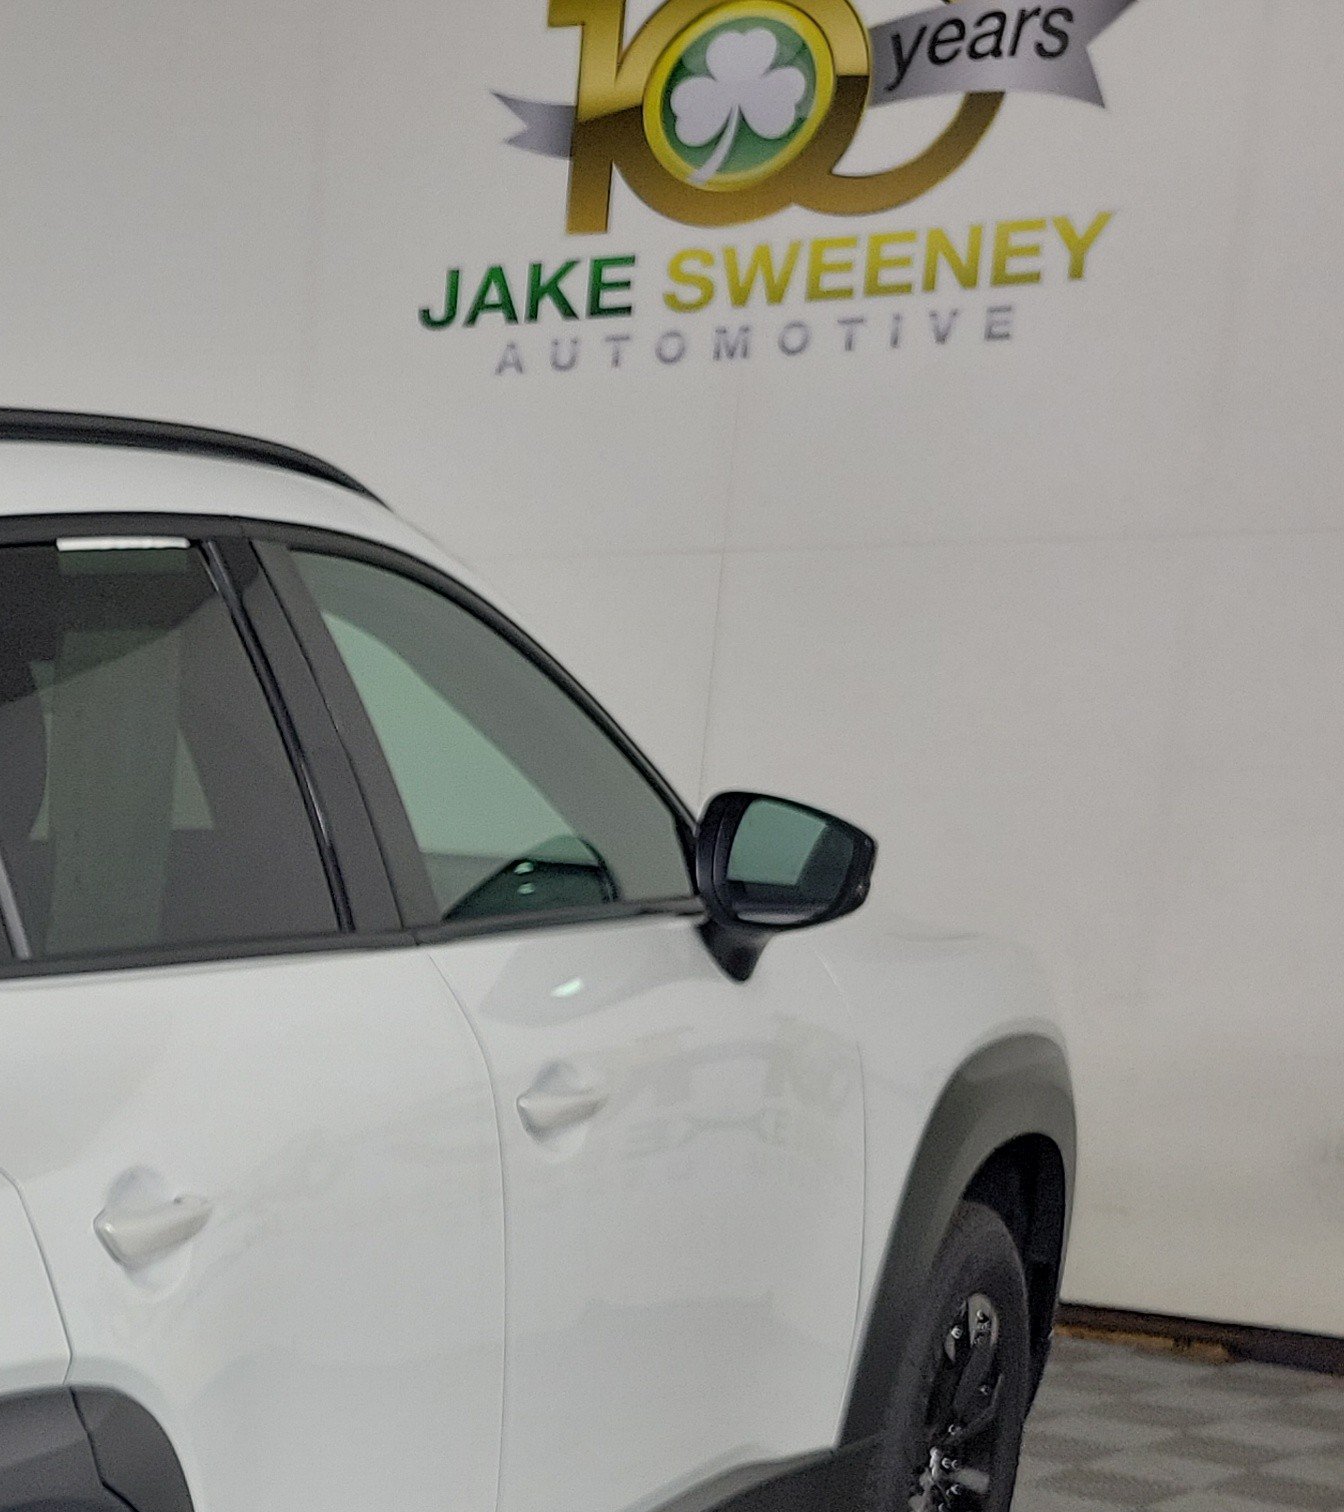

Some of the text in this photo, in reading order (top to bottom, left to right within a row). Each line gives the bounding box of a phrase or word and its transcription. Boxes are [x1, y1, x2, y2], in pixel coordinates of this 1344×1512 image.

[884, 2, 1076, 92] years
[417, 211, 1115, 332] JAKE SWEENEY
[494, 304, 1016, 377] AUTOMOTIVE
